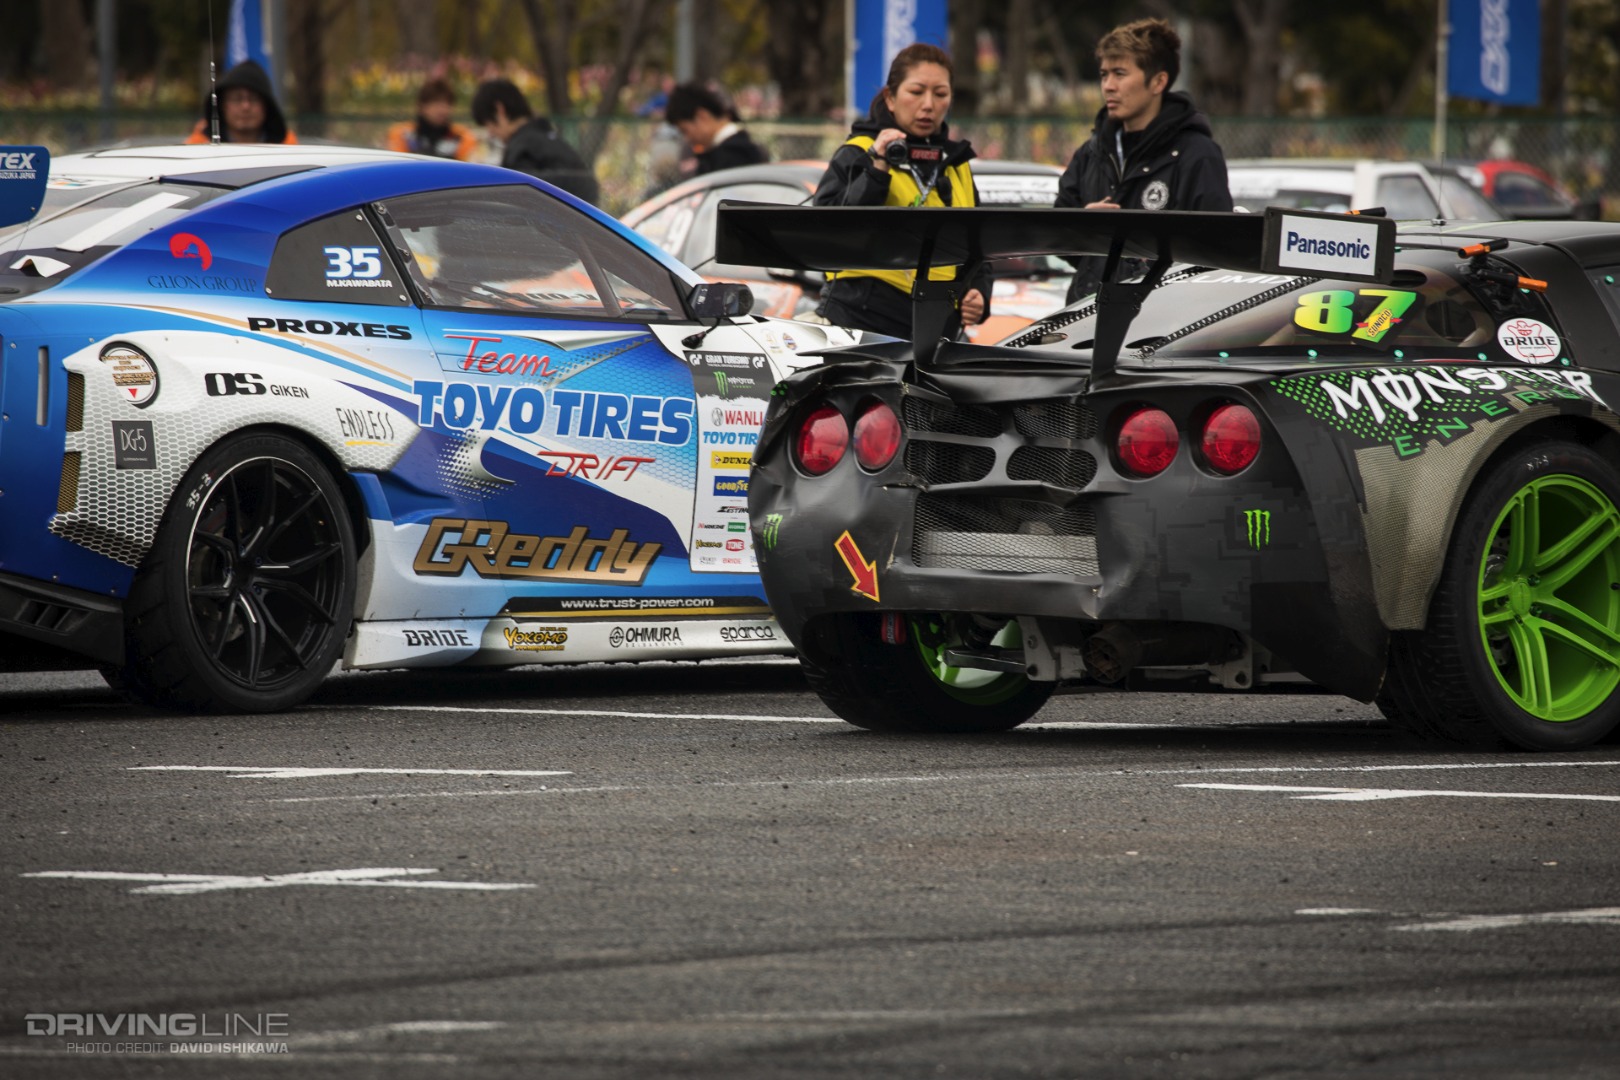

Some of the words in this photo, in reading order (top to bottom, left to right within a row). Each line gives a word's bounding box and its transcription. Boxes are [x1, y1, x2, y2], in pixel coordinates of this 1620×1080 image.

[1286, 231, 1370, 260] Panasonic
[323, 246, 382, 279] 35
[147, 275, 200, 289] GLION
[203, 276, 257, 292] GROUP
[326, 279, 393, 288] M.KAWABATA
[1294, 289, 1417, 343] 87
[1367, 309, 1391, 336] SUNOCO
[247, 317, 412, 340] PROXES
[1502, 336, 1558, 346] BRIDE
[444, 334, 557, 377] Team
[204, 373, 267, 397] OS
[270, 384, 310, 399] GIKEN
[335, 407, 395, 441] ENDLESS
[411, 379, 549, 436] TOYO
[551, 388, 697, 447] TIRES
[725, 410, 763, 426] WANLI
[703, 431, 736, 444] TOYO
[537, 450, 656, 482] DRIFT
[727, 541, 744, 549] TONE
[561, 598, 714, 610] www.trust-power.com
[402, 630, 473, 647] BRIDE
[503, 626, 568, 649] YOKOMO
[625, 627, 682, 642] OHMURA
[720, 625, 775, 643] sparco
